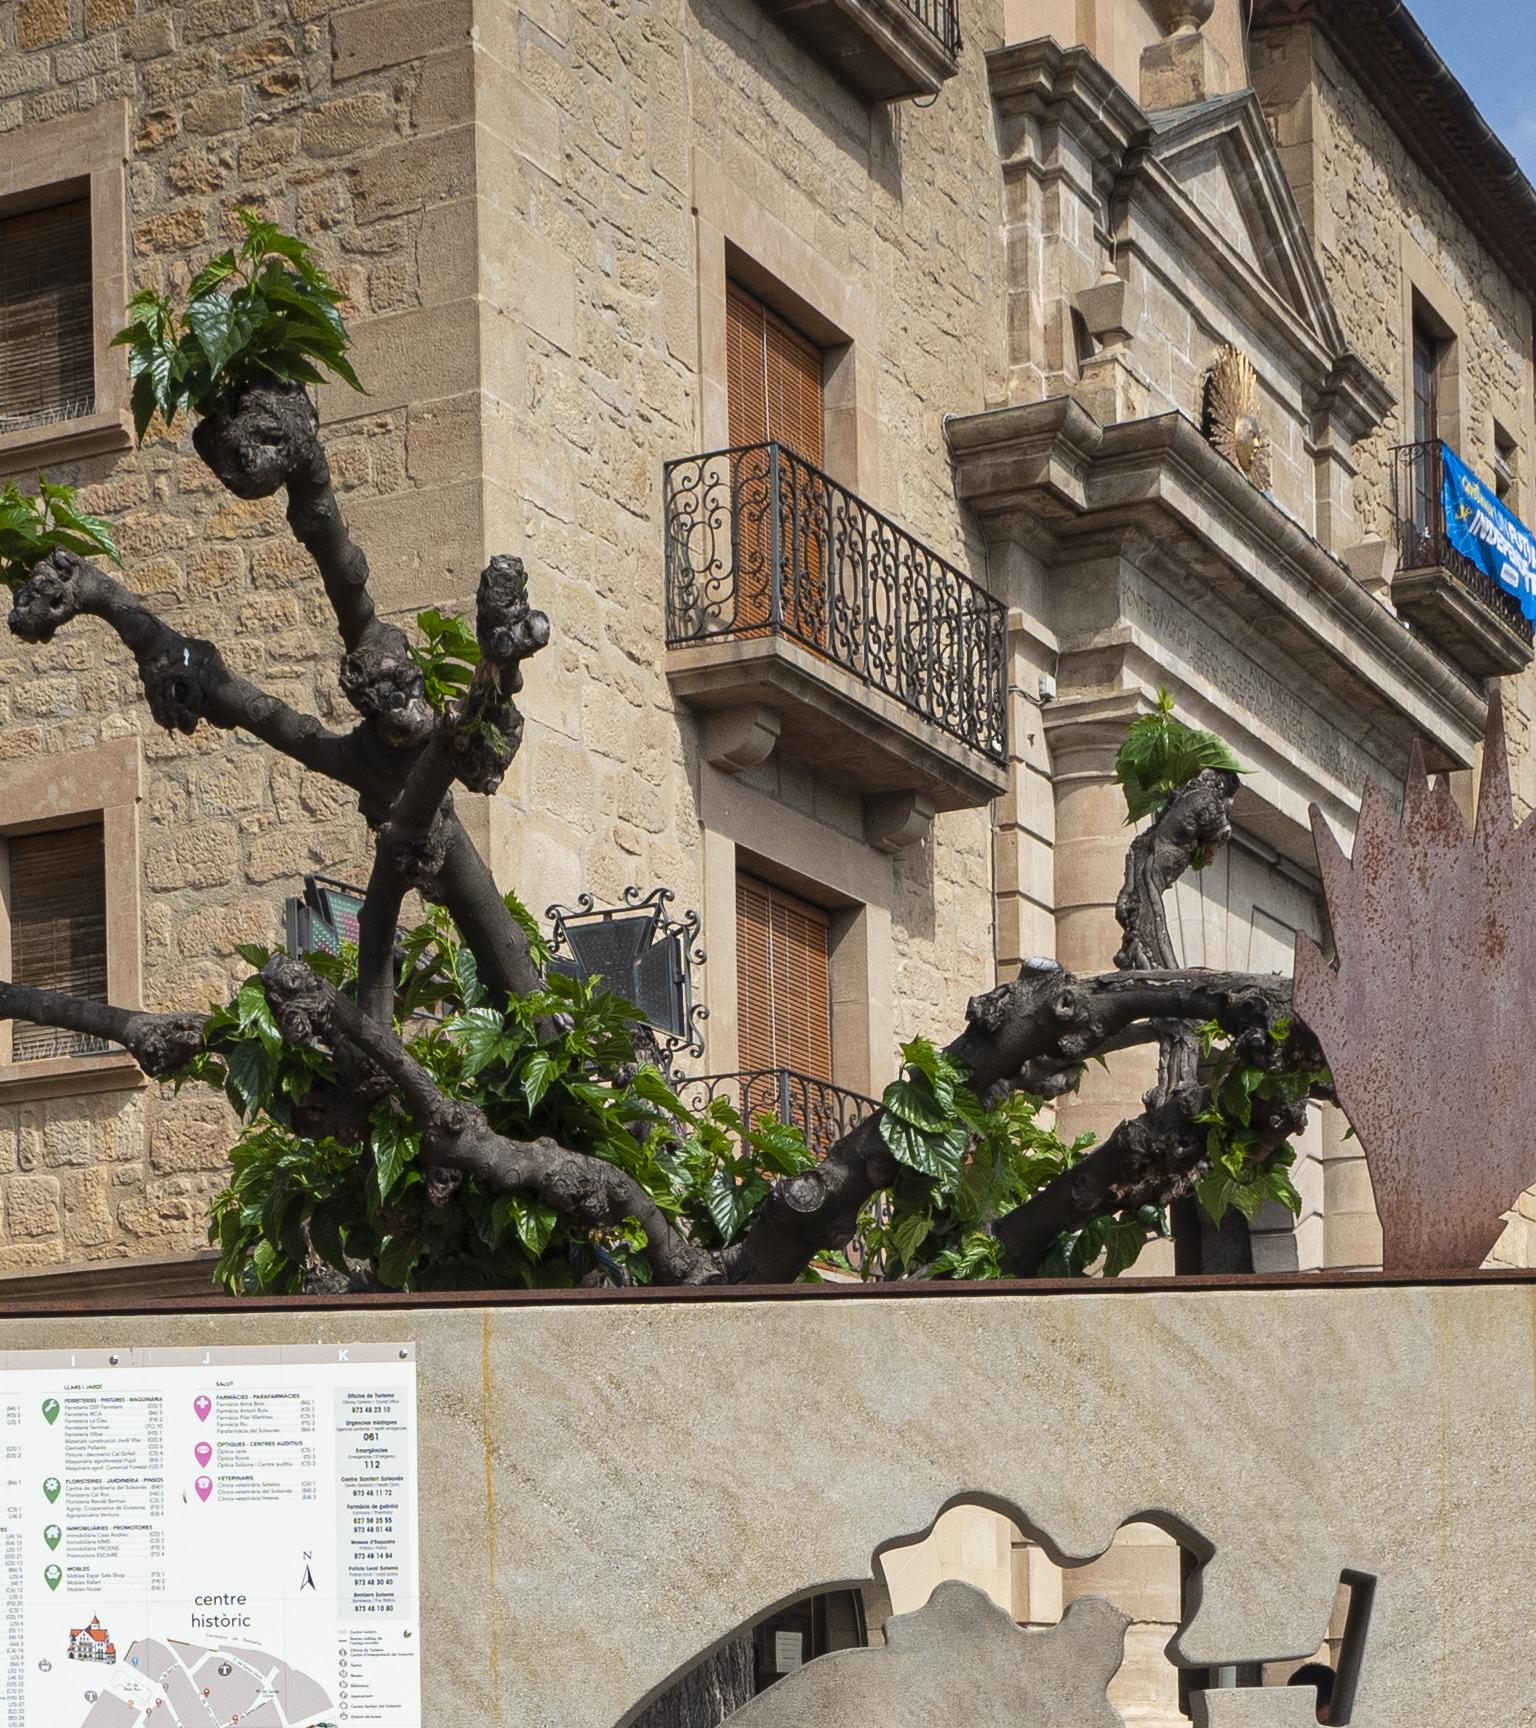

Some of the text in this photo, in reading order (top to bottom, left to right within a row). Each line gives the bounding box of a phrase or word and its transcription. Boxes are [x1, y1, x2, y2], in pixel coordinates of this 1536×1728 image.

[70, 1355, 76, 1367] I
[202, 1352, 211, 1365] J
[338, 1349, 350, 1362] K
[363, 1432, 379, 1441] 061
[365, 1460, 381, 1468] 112
[303, 1551, 313, 1560] N
[194, 1593, 247, 1606] centre
[190, 1610, 251, 1630] històric
